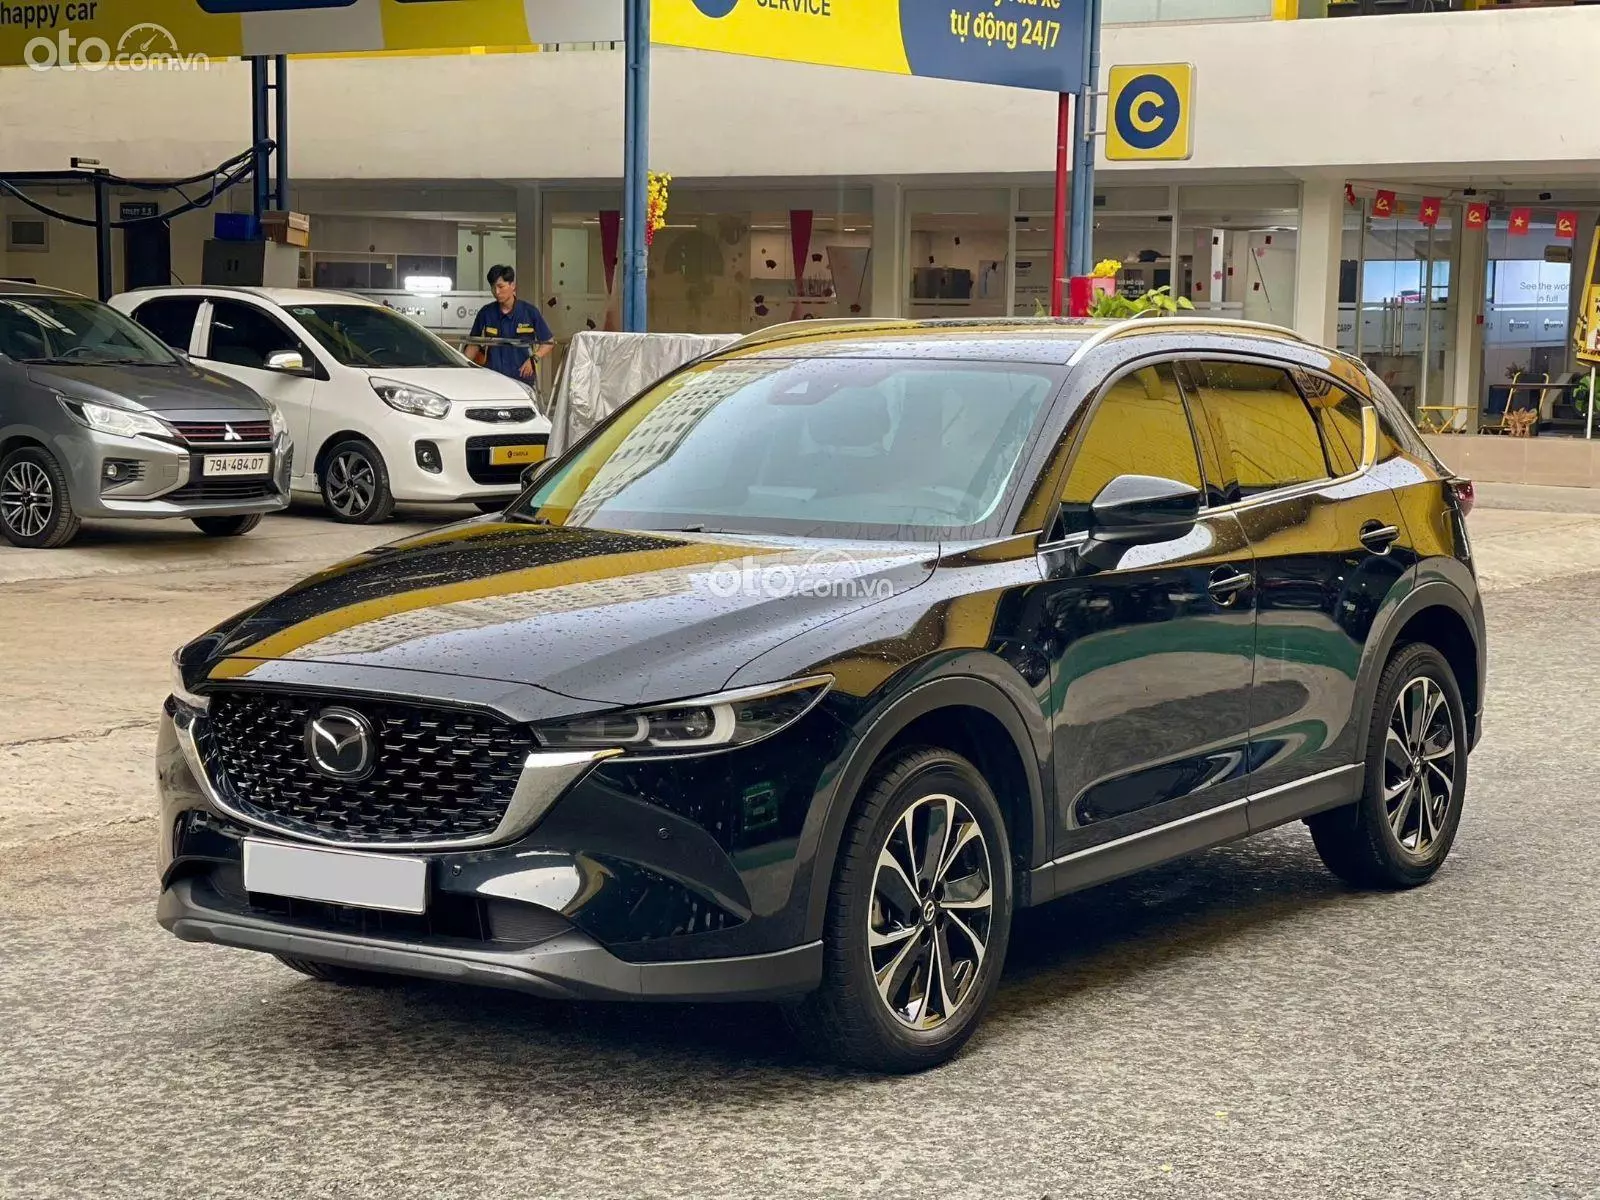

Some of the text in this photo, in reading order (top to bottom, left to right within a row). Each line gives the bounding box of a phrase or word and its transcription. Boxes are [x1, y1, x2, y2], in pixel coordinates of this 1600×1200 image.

[1, 1, 97, 28] happy car
[757, 0, 831, 16] VICE
[950, 9, 1060, 50] tự động 24/7
[1520, 282, 1537, 290] See
[1538, 282, 1551, 290] the
[1546, 294, 1558, 302] full
